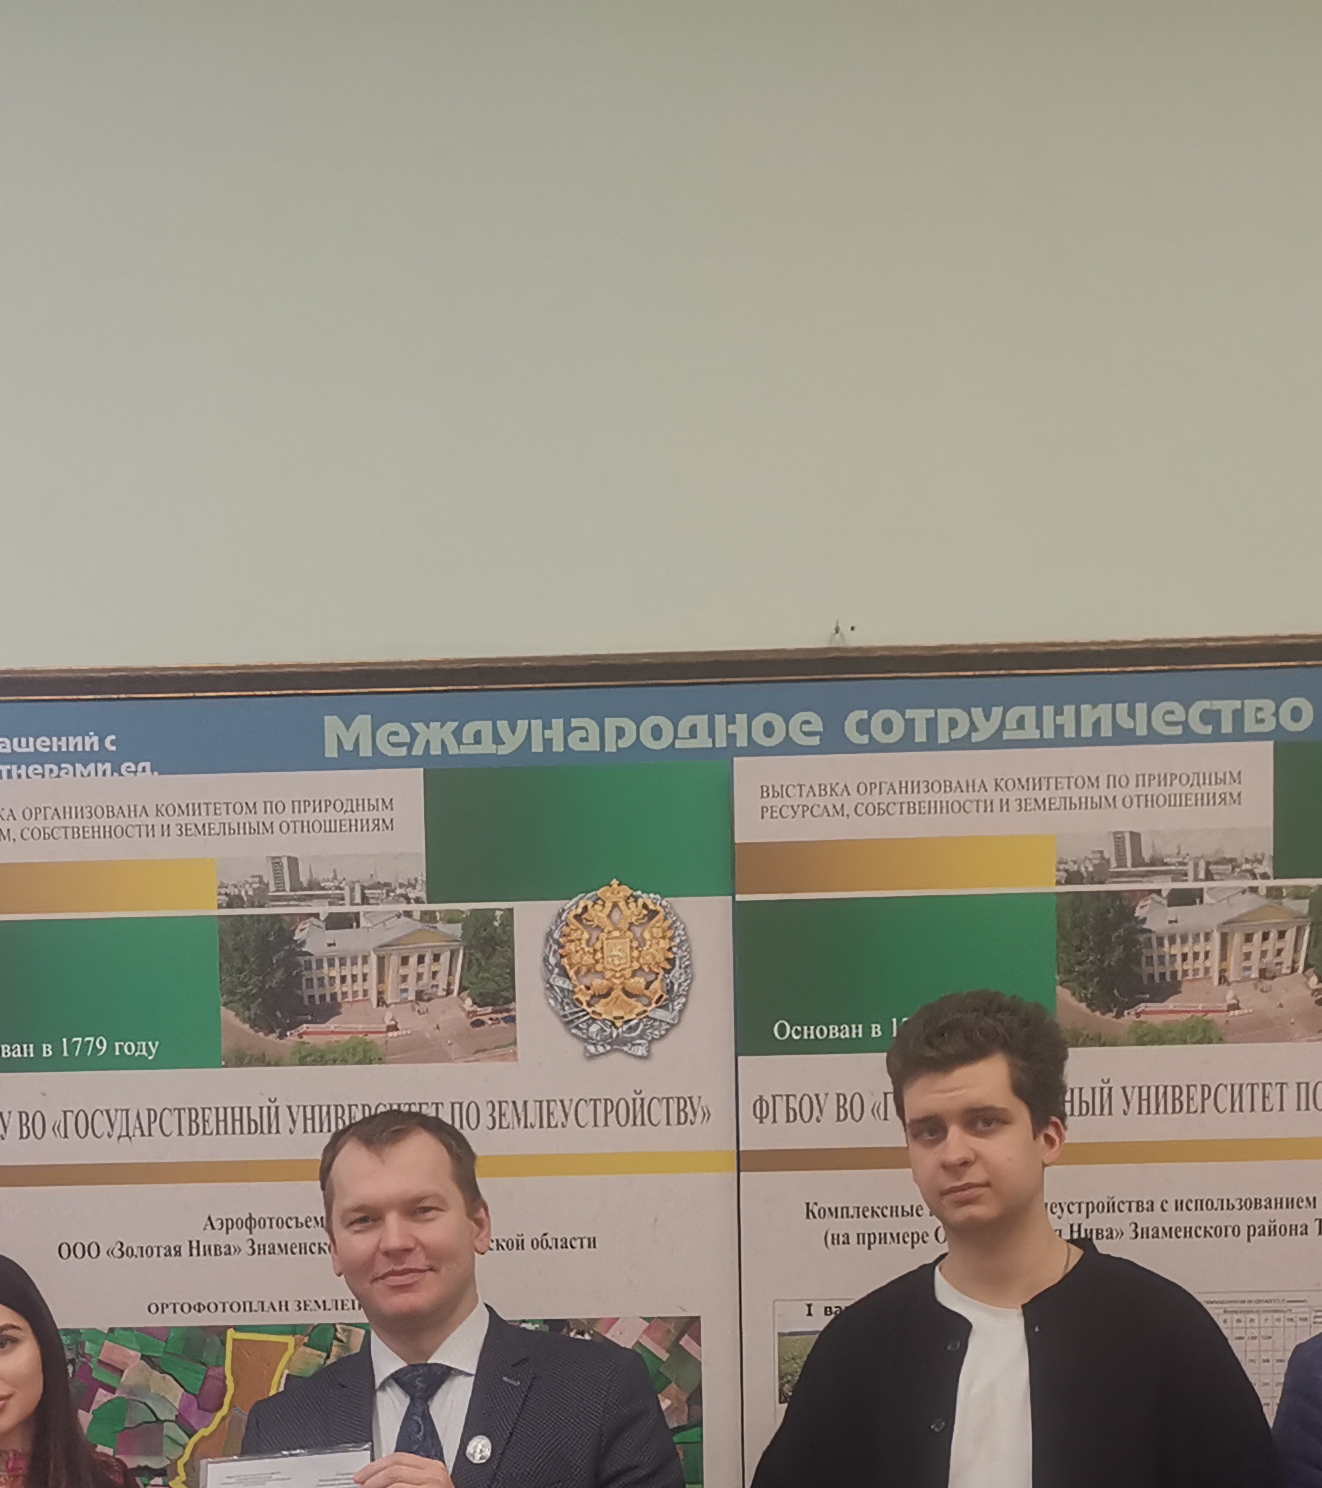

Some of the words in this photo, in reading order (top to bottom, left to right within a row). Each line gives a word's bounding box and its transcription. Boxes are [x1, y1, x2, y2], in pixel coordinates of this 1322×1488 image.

[324, 709, 823, 758] Международное
[845, 698, 1314, 745] сотрудничество
[105, 735, 116, 751] с
[759, 781, 851, 799] ВЫСТАВКА
[857, 777, 987, 796] ОРГАНИЗОВАНА
[994, 775, 1100, 791] КОМИТЕТОМ
[1106, 774, 1129, 790] ПО
[1135, 770, 1241, 788] ПРИРОДНЫМ
[22, 805, 149, 822] ОРГАНИЗОВАНА
[155, 801, 257, 819] КОМИТЕТОМ
[263, 800, 285, 816] ПО
[291, 798, 394, 815] ПРИРОДНЫМ
[759, 802, 851, 820] РЕСУРСАМ,
[854, 798, 993, 817] СОБСТВЕННОСТИ
[999, 797, 1010, 812] И
[1015, 795, 1117, 811] ЗЕМЕЛЬНЫМ
[1122, 792, 1241, 809] ОТНОШЕНИЯМ
[21, 824, 155, 841] СОБСТВЕННОСТИ
[161, 823, 171, 838] И
[176, 821, 274, 837] ЗЕМЕЛЬНЫМ
[279, 819, 394, 835] ОТНОШЕНИЯМ
[774, 1020, 863, 1041] Основан
[870, 1023, 881, 1037] в
[42, 1043, 52, 1057] в
[61, 1037, 107, 1057] 1779
[115, 1039, 159, 1059] году
[753, 1092, 829, 1124] ФГБОУ
[835, 1092, 864, 1122] ВО
[1120, 1081, 1289, 1118] УНИВЕРСИТЕТ
[19, 1111, 46, 1141] ВО
[52, 1098, 278, 1143] «ГОСУДАРСТВЕННЫЙ
[450, 1102, 480, 1130] ПО
[487, 1089, 711, 1130] ЗЕМЛЕУСТРОЙСТВУ»
[805, 1201, 923, 1221] Комплексные
[1160, 1200, 1169, 1212] с
[1175, 1193, 1316, 1214] использованием
[203, 1212, 325, 1234] Аэрофотосъем
[1129, 1220, 1240, 1241] Знаменского
[1246, 1221, 1309, 1243] района
[58, 1242, 100, 1260] ООО
[107, 1241, 182, 1261] «Золотая
[188, 1240, 242, 1259] Нива»
[246, 1237, 330, 1257] Знаменск
[531, 1232, 597, 1253] области
[824, 1230, 850, 1249] (на
[856, 1230, 929, 1249] примере
[147, 1298, 289, 1315] ОРТОФОТОПЛАН
